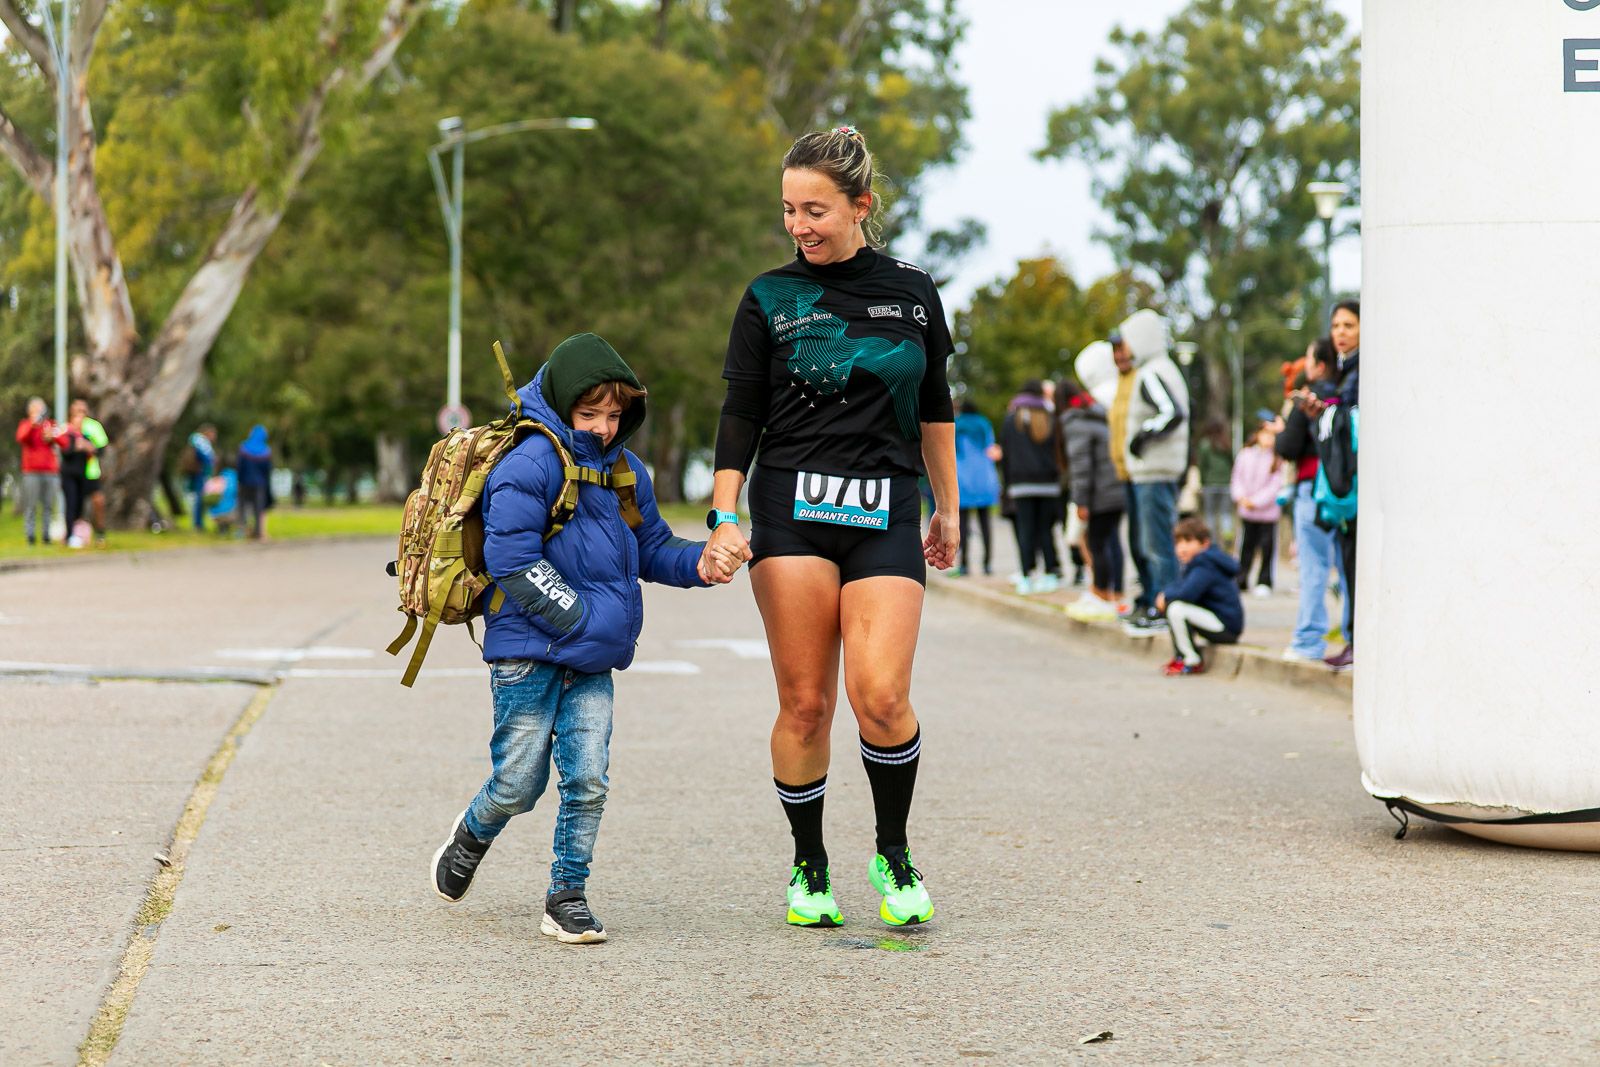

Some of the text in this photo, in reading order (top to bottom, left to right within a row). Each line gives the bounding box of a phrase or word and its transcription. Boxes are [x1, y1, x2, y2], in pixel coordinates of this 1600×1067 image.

[775, 313, 832, 333] Mercedes-Benz
[798, 509, 883, 526] DIAMANTE CORRE
[525, 567, 575, 610] BATIC
